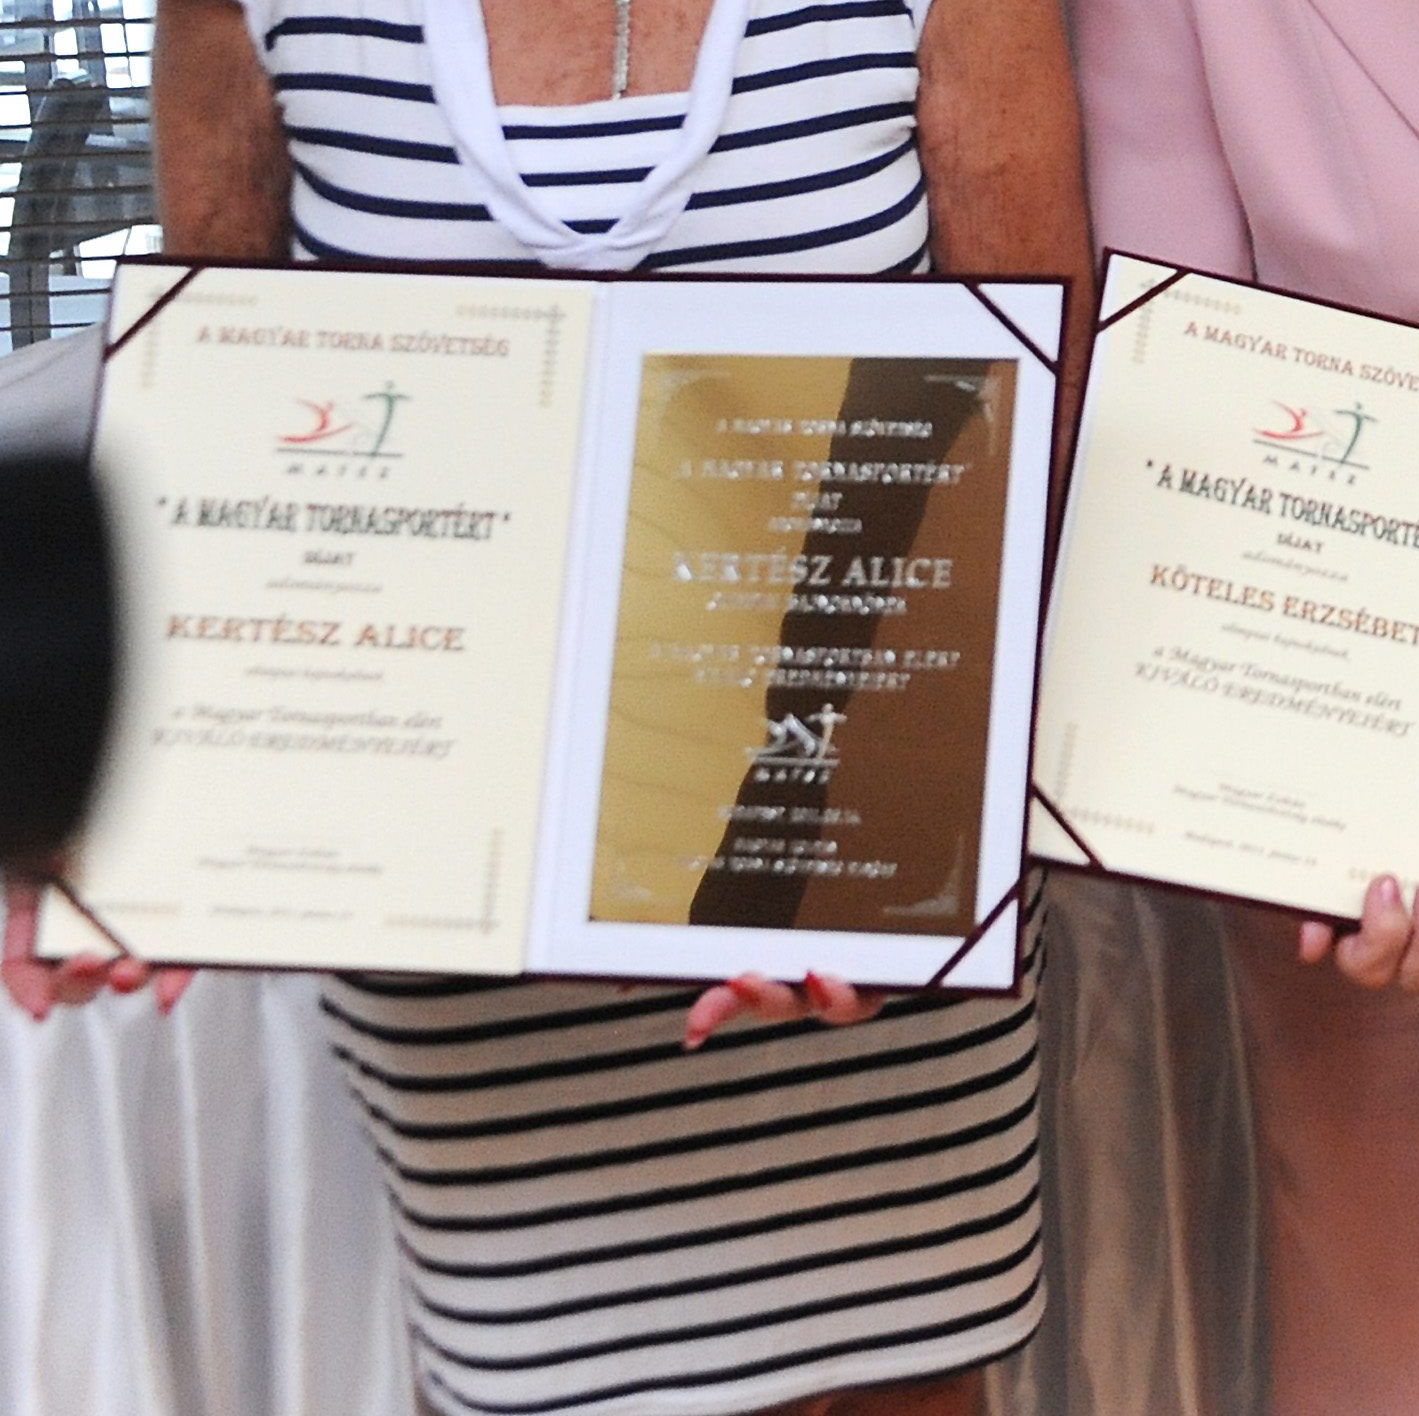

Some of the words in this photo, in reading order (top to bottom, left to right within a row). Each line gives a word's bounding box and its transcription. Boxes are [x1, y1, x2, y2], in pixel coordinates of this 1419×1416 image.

[1182, 315, 1200, 338] A
[1202, 321, 1290, 361] MAGYAR
[1291, 345, 1356, 378] TORNA
[1154, 461, 1179, 493] A
[1176, 461, 1275, 516] MAGYAR
[841, 554, 954, 589] ALICE
[1148, 557, 1277, 615] KÖTELES
[165, 609, 342, 648] KERTÉSZ
[353, 623, 468, 654] ALICE
